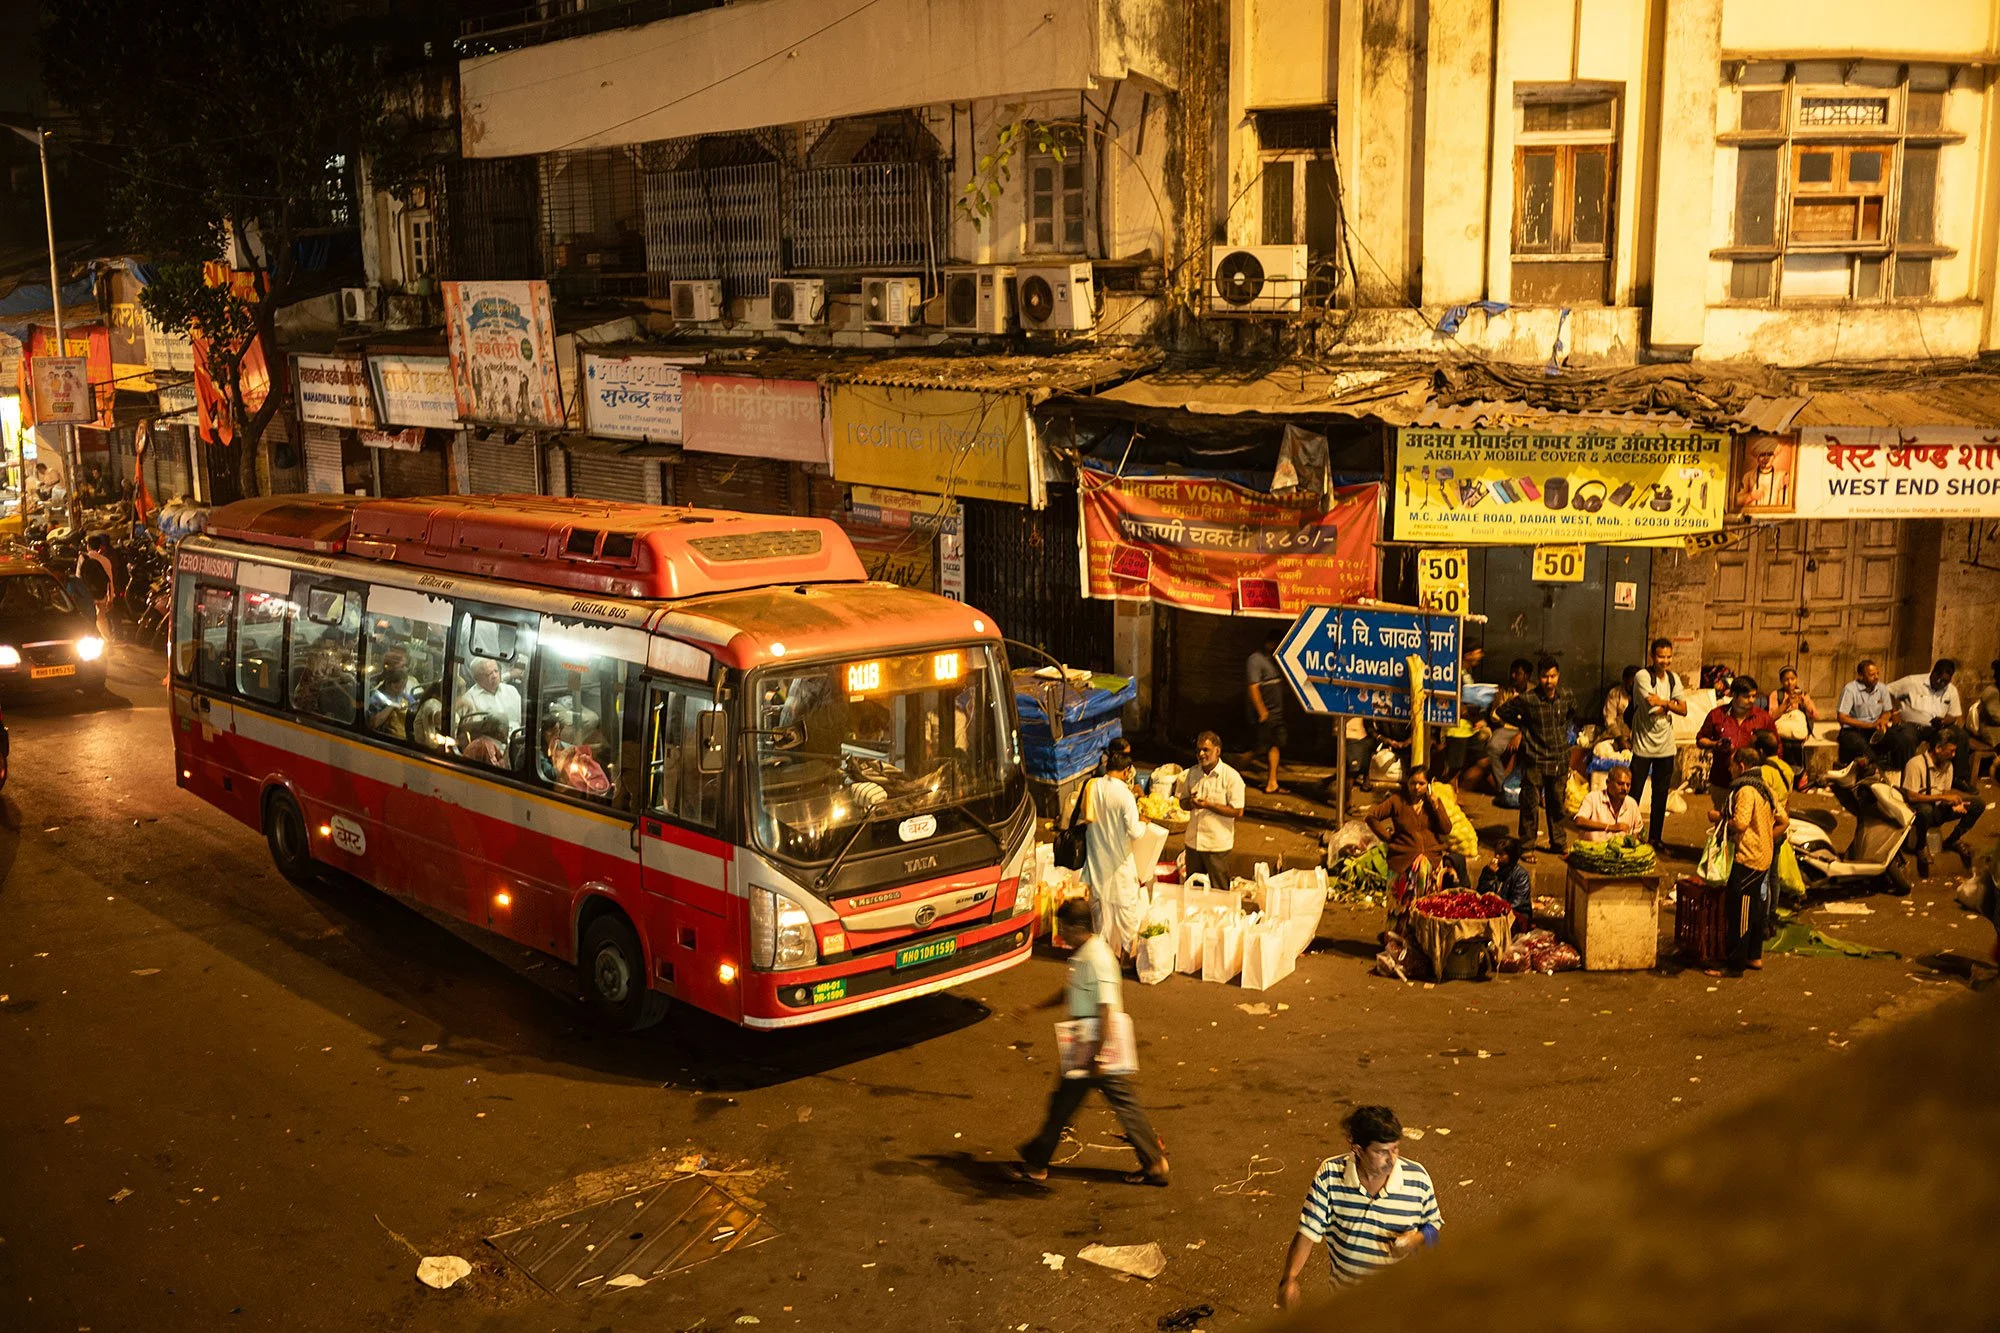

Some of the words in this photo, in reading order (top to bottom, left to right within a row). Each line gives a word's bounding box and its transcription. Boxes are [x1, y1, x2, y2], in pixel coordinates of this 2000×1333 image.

[600, 385, 651, 408] सुरेन्द्र
[686, 382, 706, 415] श्री
[848, 420, 923, 450] realme
[1406, 433, 1456, 448] अक्षय
[1424, 450, 1480, 461] AKSHAY
[1484, 451, 1536, 462] MOBILE
[1541, 452, 1586, 462] COVER
[1590, 452, 1598, 462] &
[1602, 452, 1700, 464] ACCESSORIES
[1824, 434, 1880, 472] वेस्ट
[1184, 484, 1235, 505] VORA
[1828, 478, 1890, 496] WEST
[1895, 478, 1940, 496] END
[852, 506, 880, 518] SAMSUNG
[1409, 512, 1433, 521] M.C.
[1437, 513, 1480, 522] JAWALE
[1483, 514, 1516, 524] ROAD,
[1520, 514, 1556, 524] DADAR
[1560, 516, 1593, 526] WEST,
[1634, 517, 1670, 527] 62030
[1674, 518, 1709, 528] 82986
[1189, 524, 1252, 548] चकली
[1696, 532, 1728, 548] 50
[178, 554, 199, 572] ZERO
[1430, 558, 1458, 580] 50
[1544, 554, 1575, 576] 50
[571, 600, 607, 616] DIGITAL
[608, 606, 630, 618] BUS
[1430, 590, 1459, 612] 50
[1352, 618, 1374, 647] चि.
[1379, 622, 1422, 650] जावळे
[1306, 650, 1342, 672] M.C.
[1346, 654, 1404, 678] Jawale
[1423, 662, 1454, 682] oad
[904, 856, 938, 874] TATA
[902, 940, 955, 964] MH01DR1599
